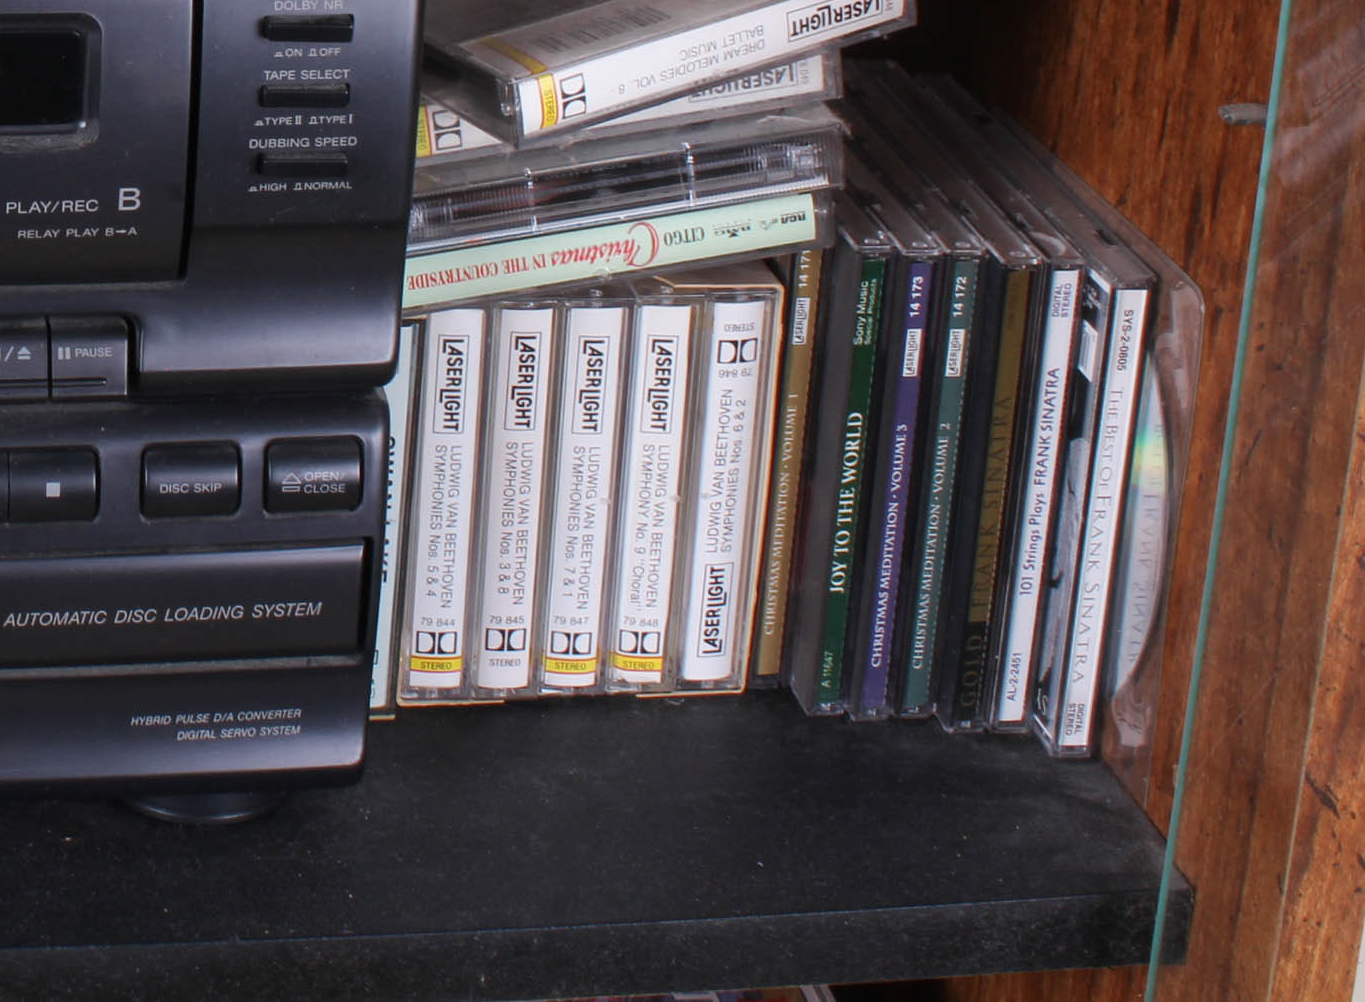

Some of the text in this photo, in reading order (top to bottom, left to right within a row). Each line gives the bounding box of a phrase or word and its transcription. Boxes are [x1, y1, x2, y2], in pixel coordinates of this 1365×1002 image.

[274, 0, 343, 11] DOLBY NR
[679, 25, 764, 57] BALLET MUSIC
[264, 69, 350, 80] TAPE SELECT
[659, 40, 765, 82] DREAM MELODIES
[249, 136, 357, 149] DUBBING SPEED
[6, 188, 140, 214] PLAY/REC B
[407, 221, 705, 291] CITGO Christmas IN THE COUNTRYSIDE
[75, 347, 112, 357] PAUSE
[1116, 309, 1134, 371] SYS-2-0805
[439, 339, 465, 431] LASERLIGHT
[510, 336, 537, 428] LASERLIGHT
[578, 339, 605, 432] LASERLIGHT
[647, 339, 673, 431] LASERLIGHT
[1107, 387, 1124, 418] THE
[304, 471, 347, 482] OPEN/
[637, 444, 655, 518] SYMPHONY
[705, 389, 733, 553] LUDWIG VAN BEETHOVEN
[1098, 425, 1118, 461] BEST
[160, 483, 222, 493] DISC SKIP
[304, 484, 345, 493] CLOSE
[429, 445, 446, 530] SYMPHONIES
[501, 442, 518, 527] SYMPHONIES
[568, 446, 586, 532] SYMPHONIES
[720, 468, 740, 553] SYMPHONIES
[829, 412, 863, 594] JOY TO THE WORLD
[1019, 368, 1060, 596] 101 Strings Plays FRANK SINATRA
[440, 445, 463, 608] LUDWIG VAN BEETHOVEN
[512, 442, 534, 605] LUDWIG VAN BEETHOVEN
[577, 446, 600, 609] LUDWIG VAN BEETHOVEN
[646, 444, 670, 608] LUDWIG VAN BEETHOVEN
[871, 434, 907, 667] CHRISTMAS MEDITATION VOLUME
[912, 436, 949, 669] CHRISTMAS MEDITATION VOLUME
[1088, 495, 1112, 571] FRANK
[4, 602, 322, 626] AUTOMATIC DISC LOADING SYSTEM
[702, 566, 727, 654] LASERLIGHT
[1072, 583, 1100, 683] SINATRA
[1006, 652, 1022, 701] AL-2-2451
[131, 709, 301, 726] HYBRID PULSE D/A CONVERTER
[177, 725, 301, 741] DIGITAL SERVO SYSTEM
